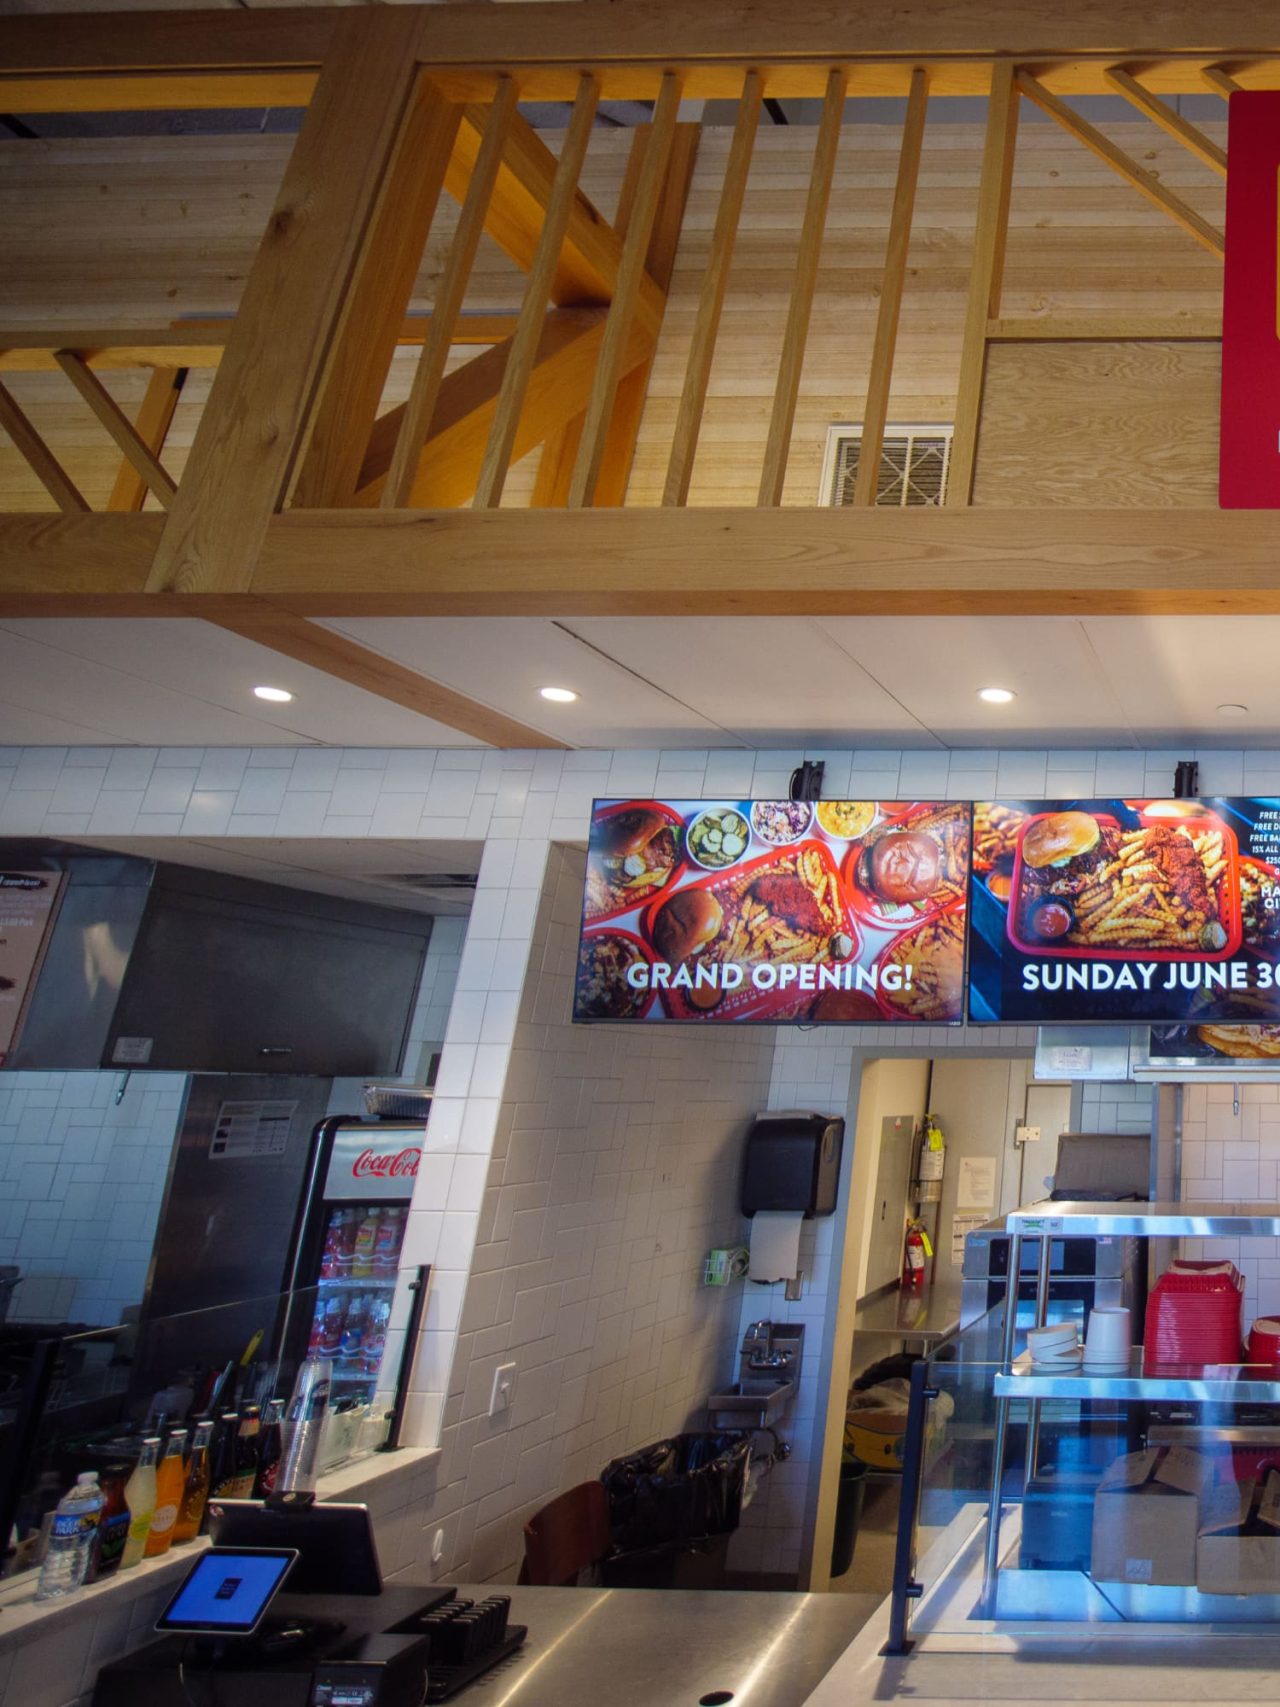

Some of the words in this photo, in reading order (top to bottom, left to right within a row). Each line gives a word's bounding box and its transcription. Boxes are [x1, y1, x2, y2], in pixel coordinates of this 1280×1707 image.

[1259, 811, 1278, 819] FREE
[1253, 822, 1272, 830] FREE
[1250, 834, 1268, 842] FREE
[1252, 845, 1264, 853] 15%
[1265, 845, 1278, 853] ALL
[626, 962, 744, 989] GRAND
[752, 964, 913, 990] OPENING!
[1022, 962, 1157, 990] SUNDAY
[1163, 962, 1248, 989] JUNE
